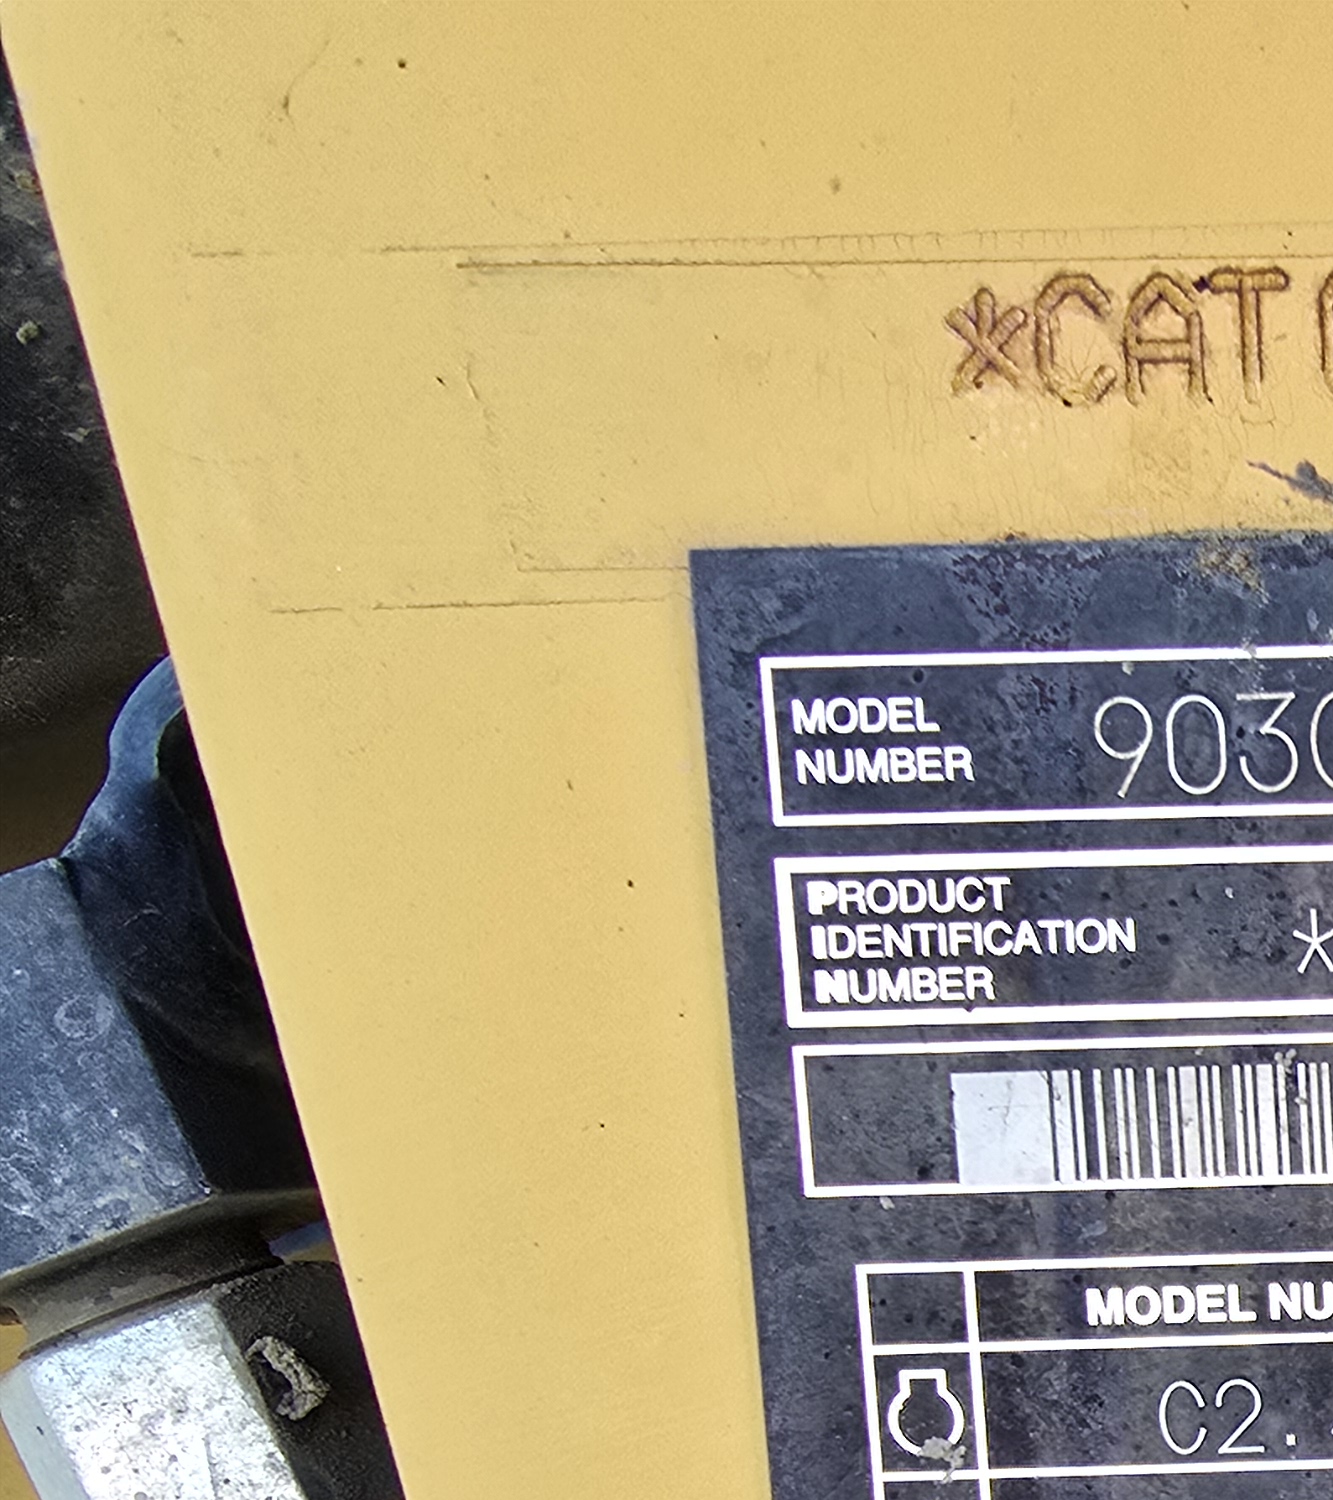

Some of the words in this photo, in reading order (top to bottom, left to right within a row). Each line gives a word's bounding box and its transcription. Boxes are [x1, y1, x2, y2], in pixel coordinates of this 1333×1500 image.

[791, 697, 940, 735] MODEL
[796, 746, 975, 785] NUMBER
[807, 877, 1011, 915] PRODUCT
[811, 918, 1136, 960] IDENTIFICATION
[814, 966, 996, 1004] NUMBER
[1086, 1284, 1256, 1325] MODEL
